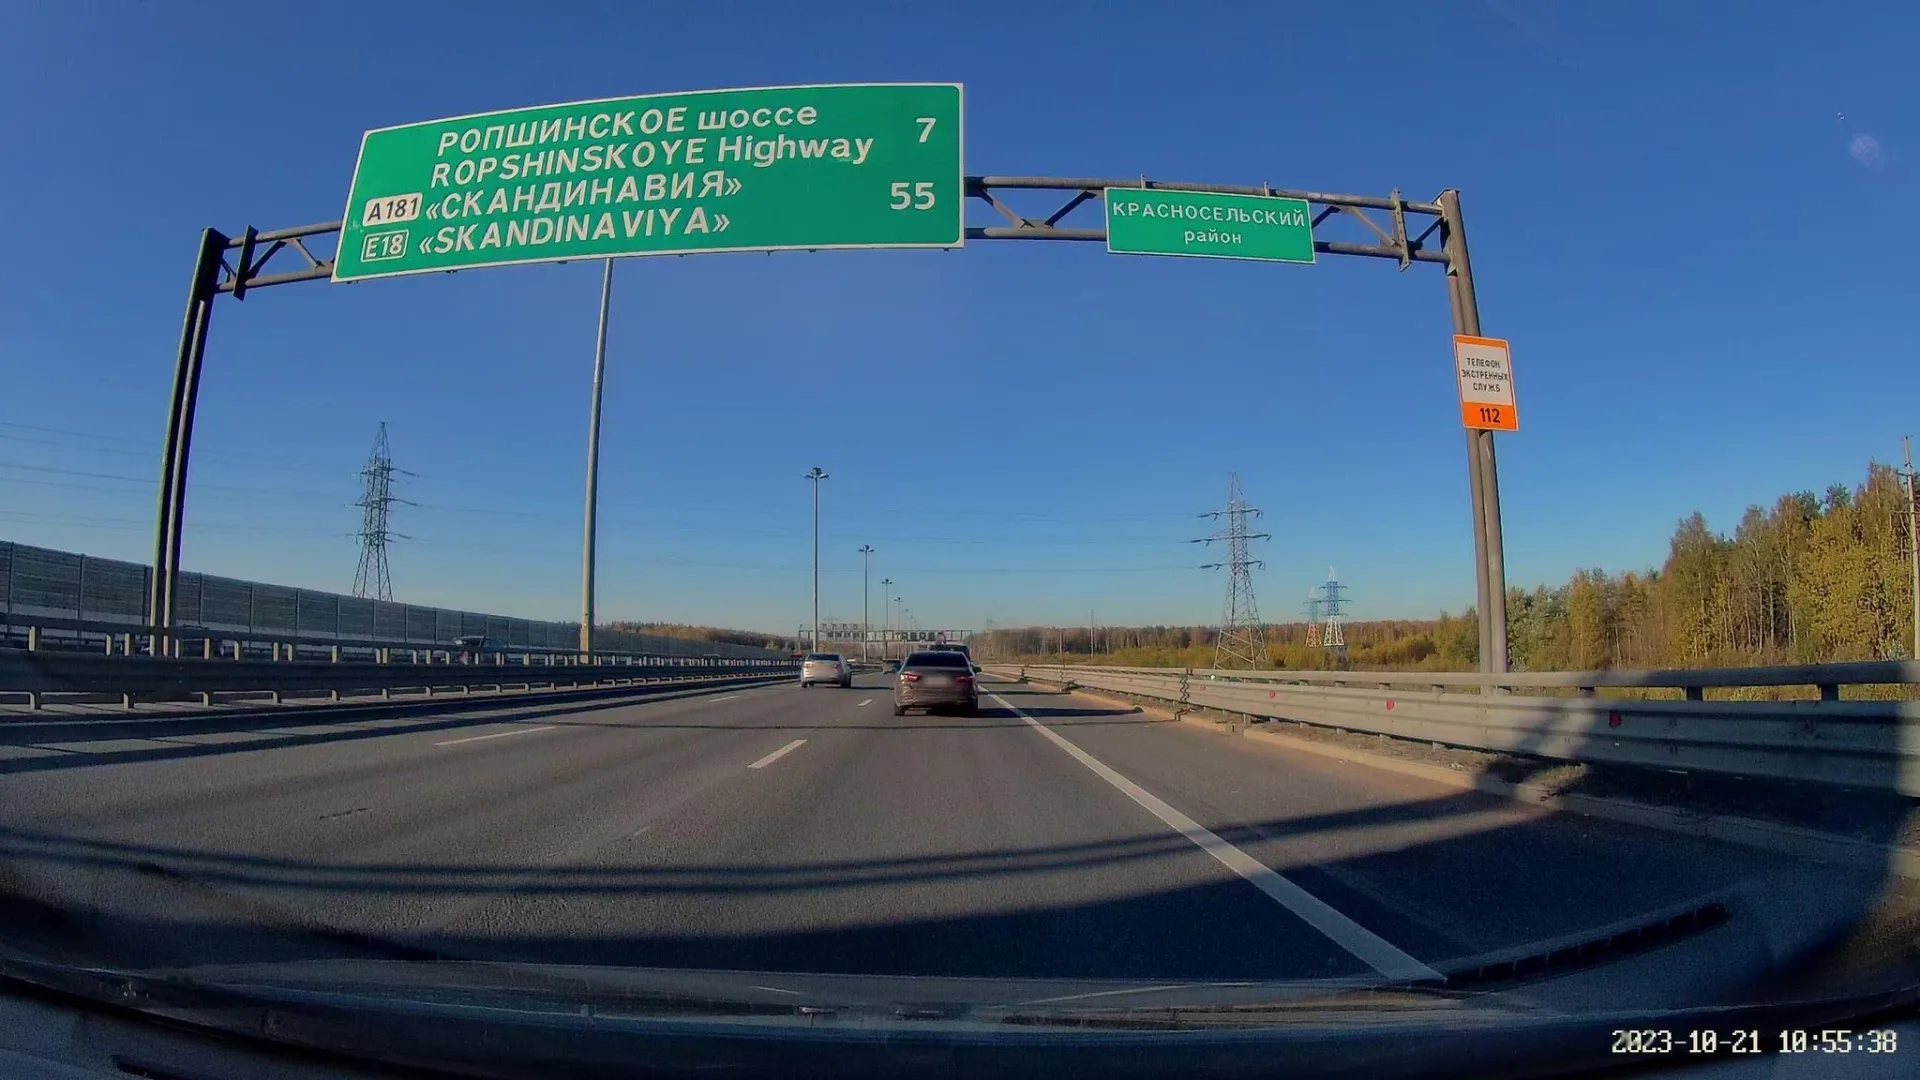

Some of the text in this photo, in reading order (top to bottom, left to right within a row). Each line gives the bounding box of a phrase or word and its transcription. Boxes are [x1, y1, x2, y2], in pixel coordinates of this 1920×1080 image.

[437, 105, 818, 156] РОПШИНСКОЕ шоссе
[915, 117, 937, 143] 7
[430, 133, 874, 188] ROPSHINSKOYE Highway
[425, 170, 743, 220] «СКАНДИНАВИЯ»
[889, 182, 937, 210] 55
[1112, 201, 1306, 227] КРАСНОСЕЛЬСКИЙ
[418, 206, 731, 254] «SKANDINAVIYA»
[1184, 229, 1243, 245] район
[364, 234, 403, 258] E18
[1461, 369, 1509, 381] ЭКСТРЕННЫХ
[1466, 357, 1501, 369] ТЕЛЕФОН
[1479, 407, 1501, 423] 112
